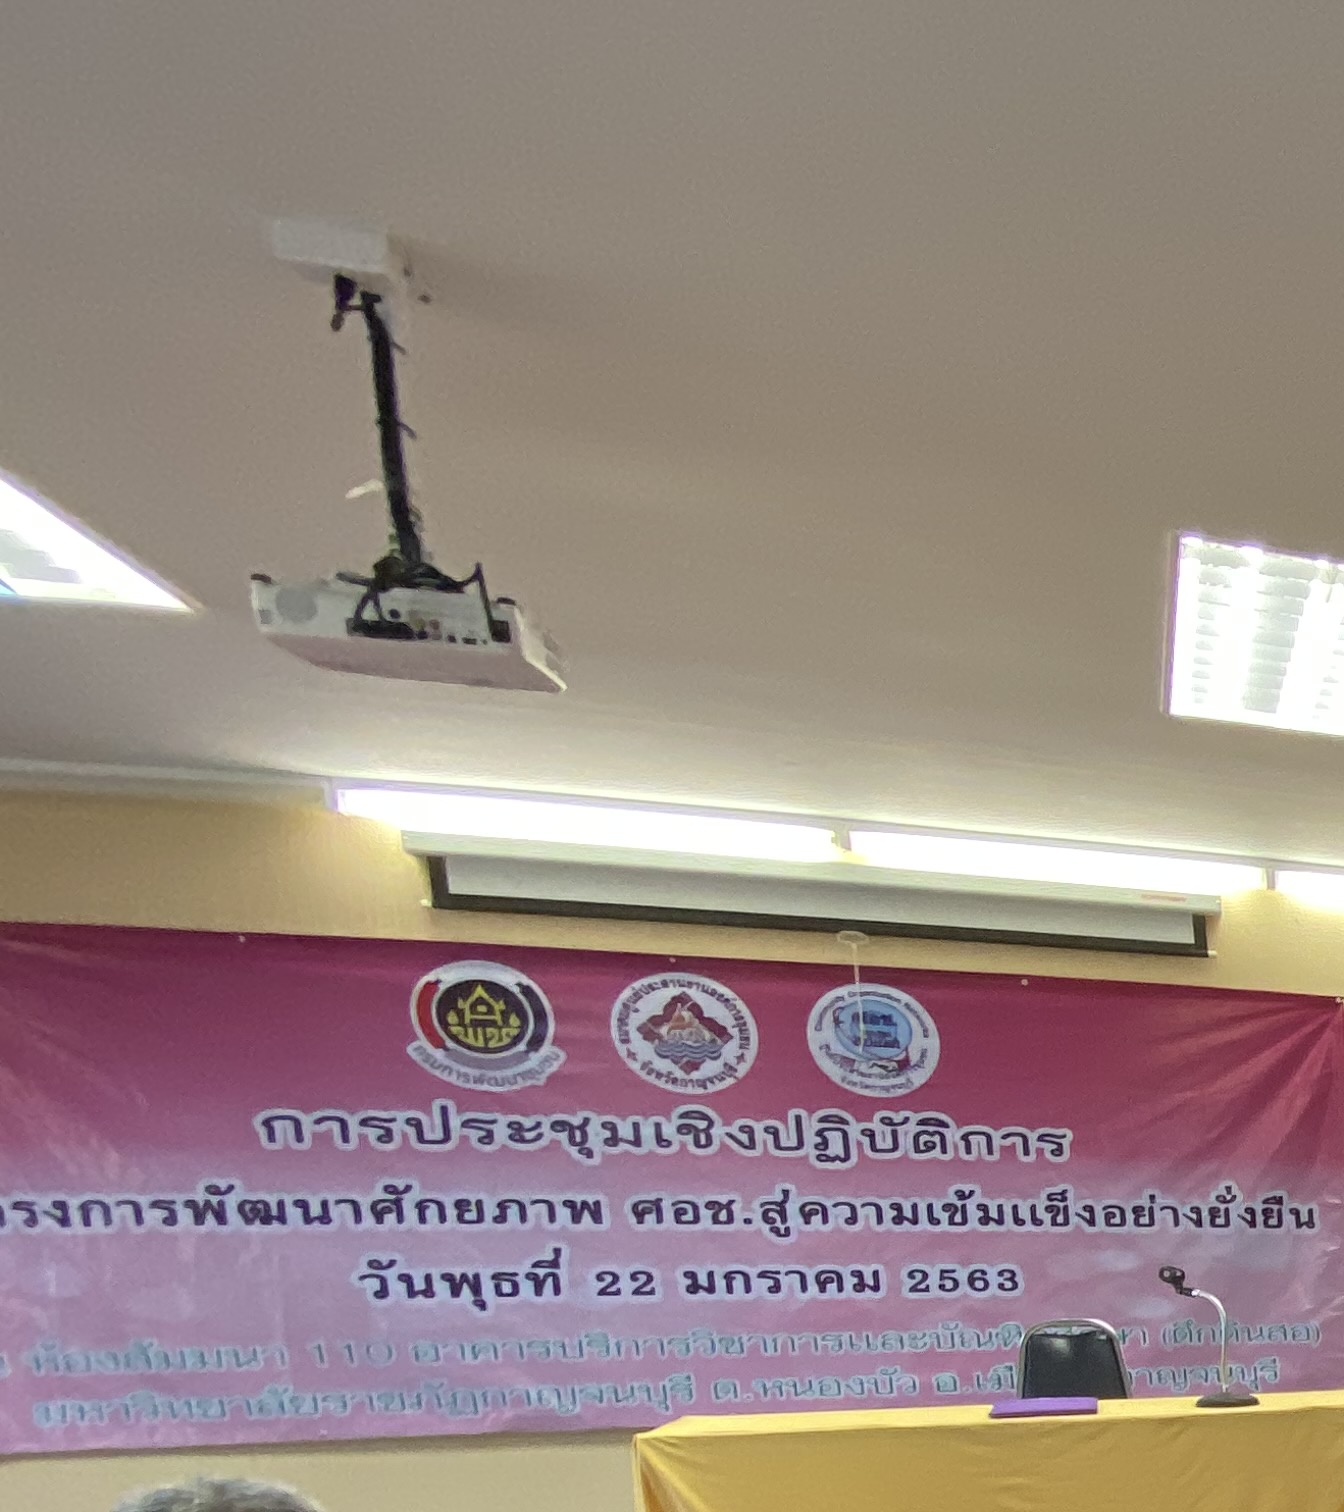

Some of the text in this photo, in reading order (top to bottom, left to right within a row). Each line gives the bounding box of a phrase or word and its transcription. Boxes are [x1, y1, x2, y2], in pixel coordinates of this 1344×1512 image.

[261, 1104, 1067, 1163] การประชุมเชิงปฏิบัติการ
[632, 1186, 1316, 1238] ศอช.สู่ความเข้มแข็งอย่างยั่งยืน
[359, 1247, 1022, 1312] วันพุธที่ 22 มกราคม 2563
[32, 1340, 288, 1372] ห้องสัมมนา
[311, 1342, 394, 1367] 110
[34, 1374, 694, 1424] มหาวิทยาลัยราชภัฏกาญจนบุรี
[712, 1367, 918, 1400] ต.หนองบัว
